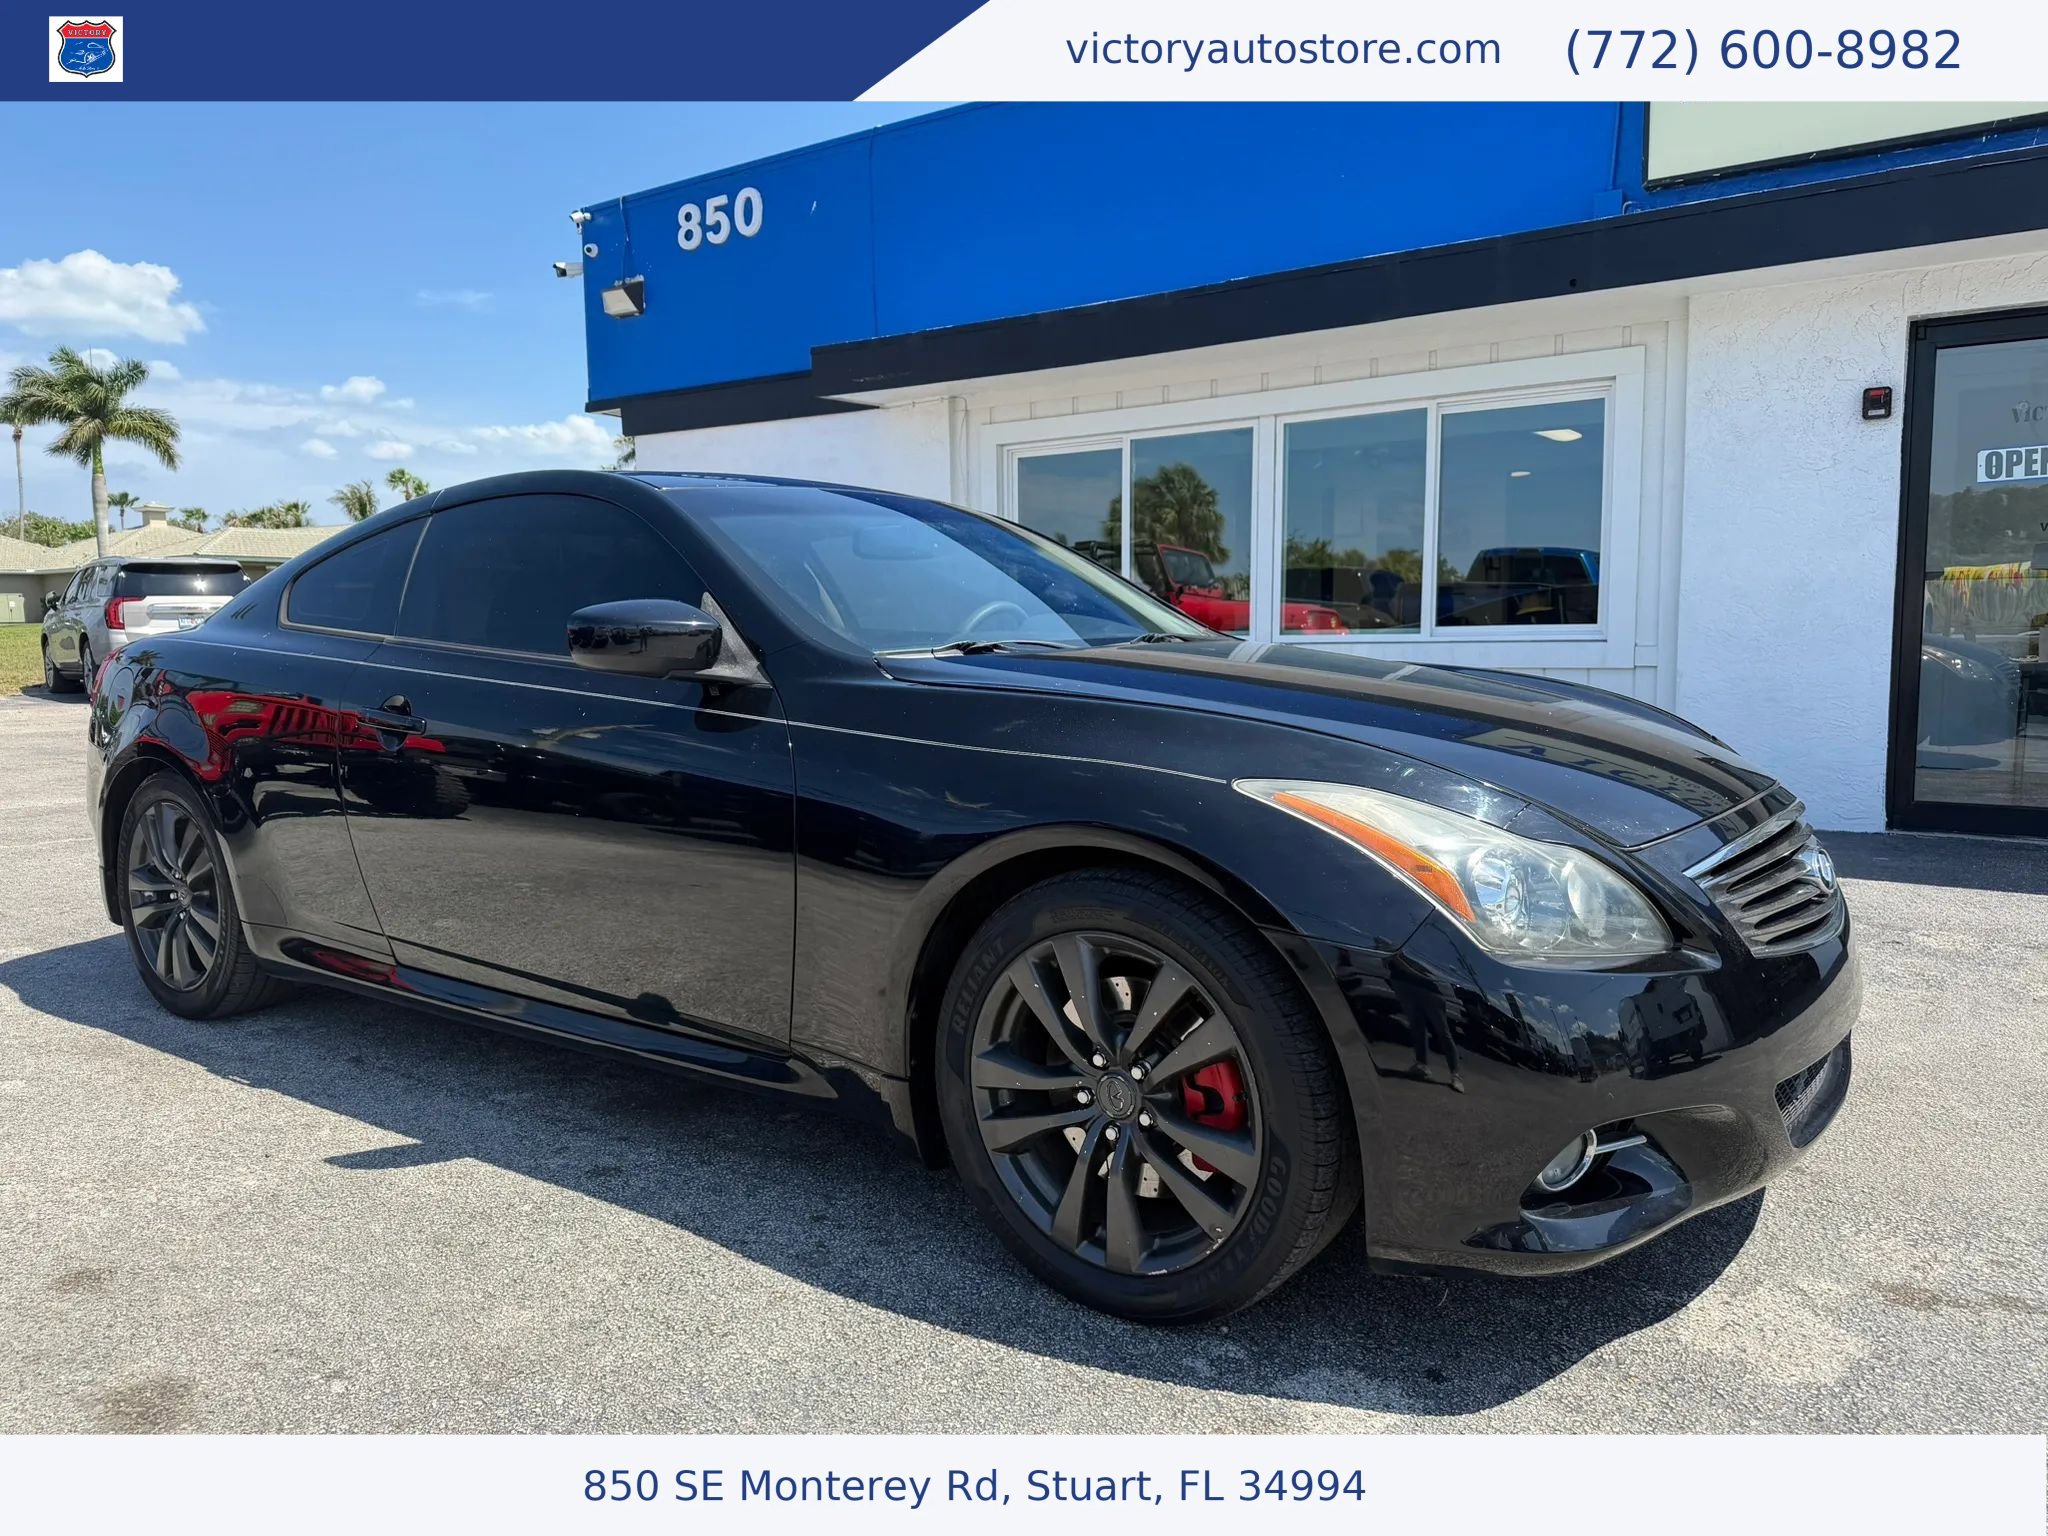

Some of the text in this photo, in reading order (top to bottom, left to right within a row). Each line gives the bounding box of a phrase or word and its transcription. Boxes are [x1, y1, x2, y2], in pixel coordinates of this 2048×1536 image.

[677, 187, 764, 251] 850
[2012, 406, 2048, 423] VIC
[952, 935, 1004, 1036] RELIANT
